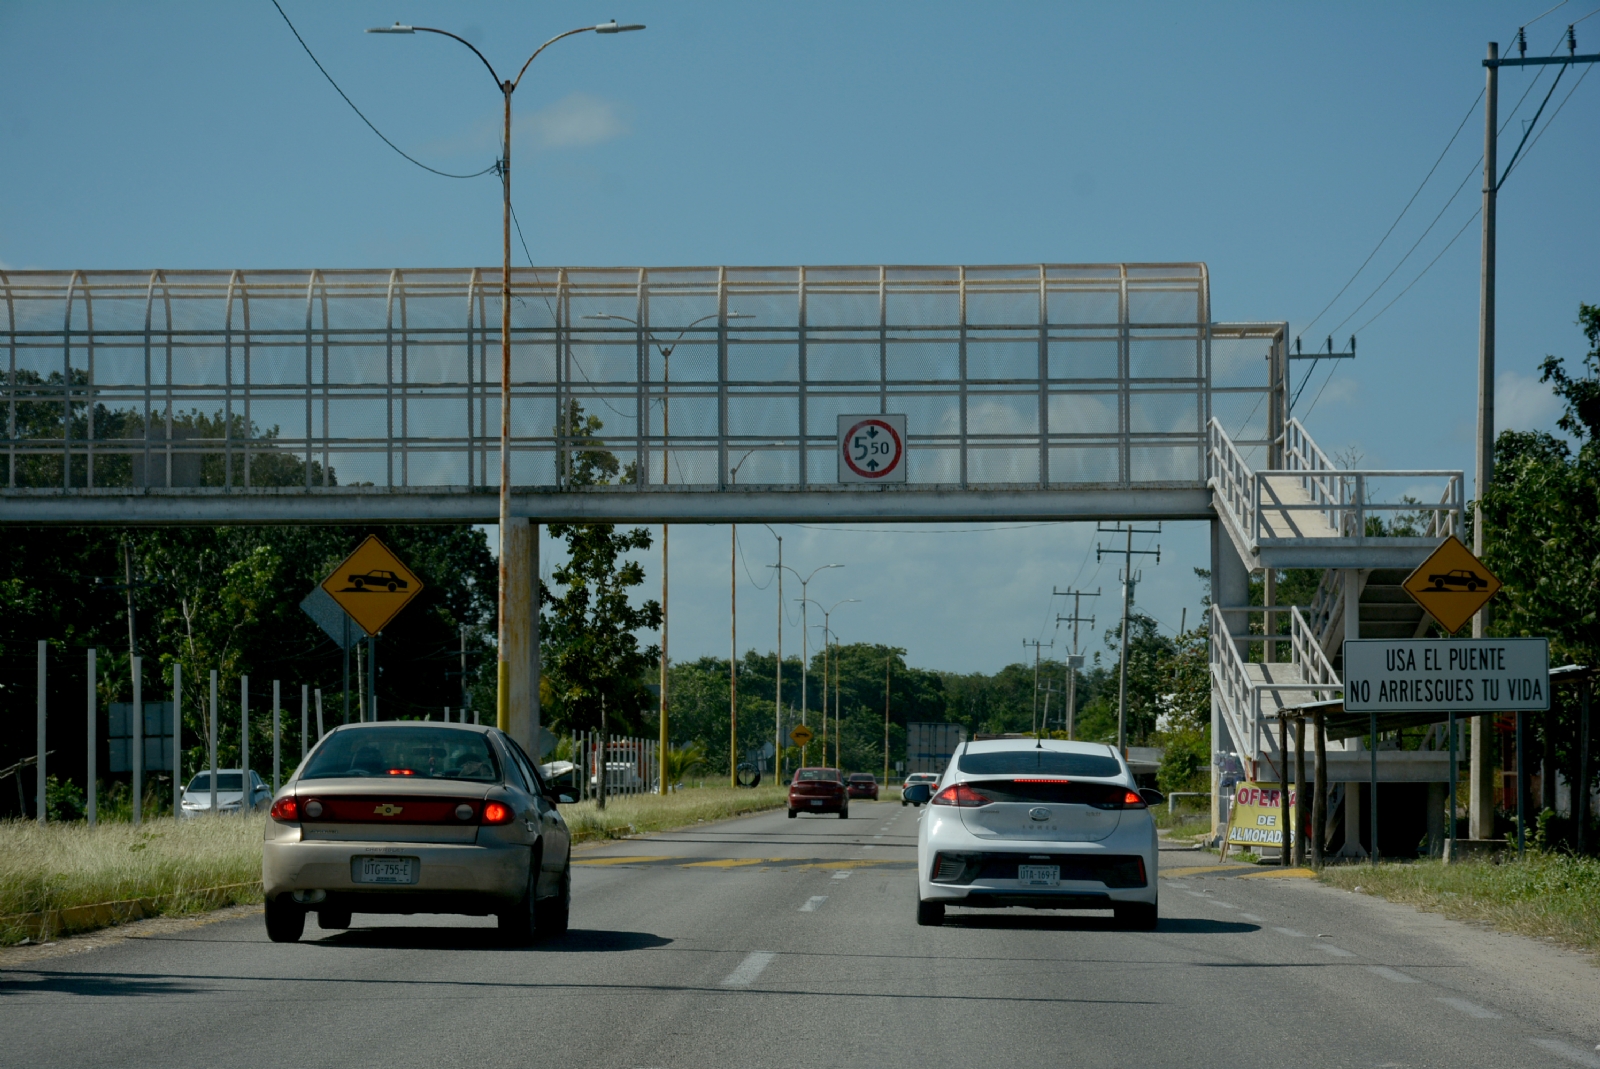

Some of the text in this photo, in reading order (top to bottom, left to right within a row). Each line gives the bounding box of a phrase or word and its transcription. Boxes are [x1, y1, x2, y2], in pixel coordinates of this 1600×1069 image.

[854, 436, 890, 461] 5 50
[1386, 647, 1506, 672] USA EL PUENTE
[1350, 678, 1543, 703] NO ARRIESGUES TU VIDA
[1237, 787, 1296, 808] OFERA
[1256, 814, 1277, 826] DE
[1229, 826, 1296, 844] ALMOHADS
[364, 863, 409, 876] UTG-755-E
